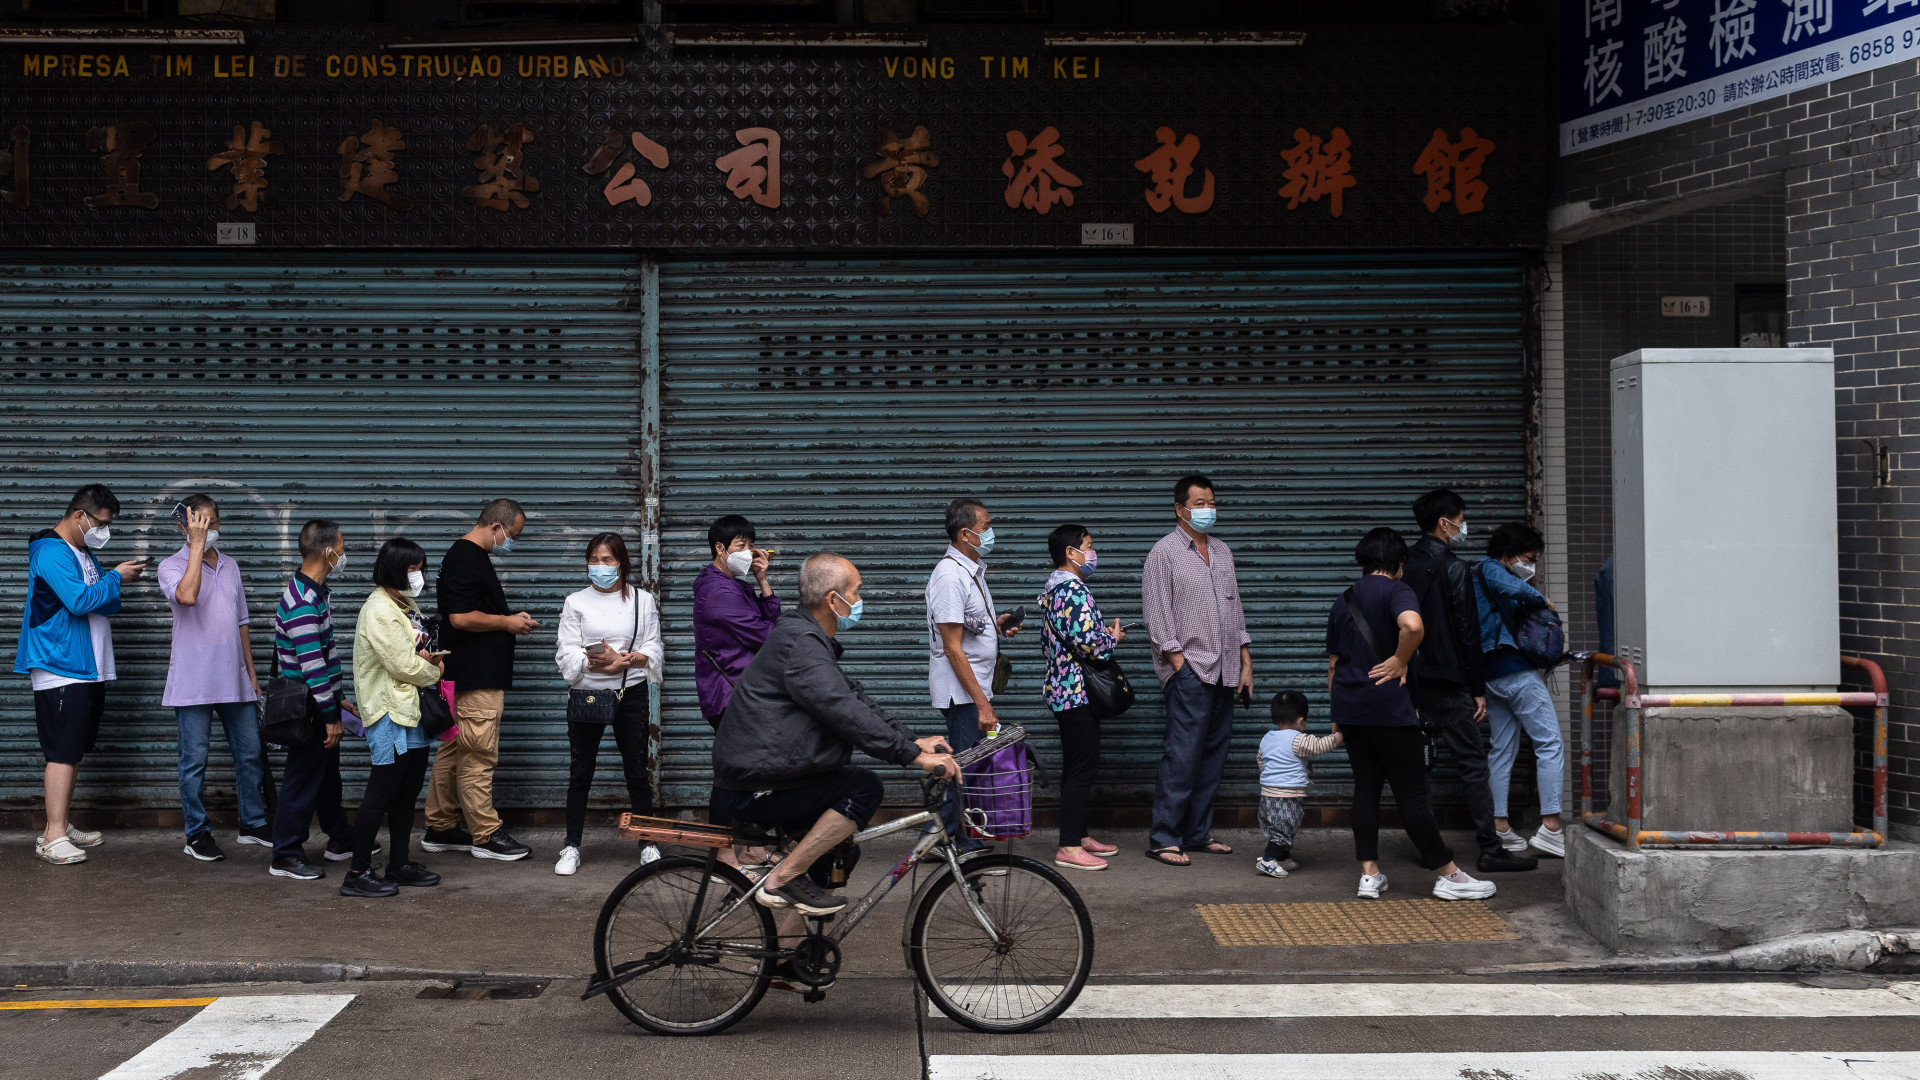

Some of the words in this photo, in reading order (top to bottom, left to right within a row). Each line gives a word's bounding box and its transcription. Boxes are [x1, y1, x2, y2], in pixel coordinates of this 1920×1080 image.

[149, 54, 193, 78] TIM
[213, 54, 255, 78] LEI
[274, 55, 306, 78] DE
[325, 48, 502, 81] CONSTRUÇÃO
[518, 53, 626, 79] URBANO
[1583, 0, 1920, 107] 核酸檢測
[1849, 35, 1895, 65] 6858
[883, 55, 955, 80] VONG
[979, 55, 1029, 79] TIM
[1053, 56, 1100, 79] KEI
[237, 226, 249, 240] 18
